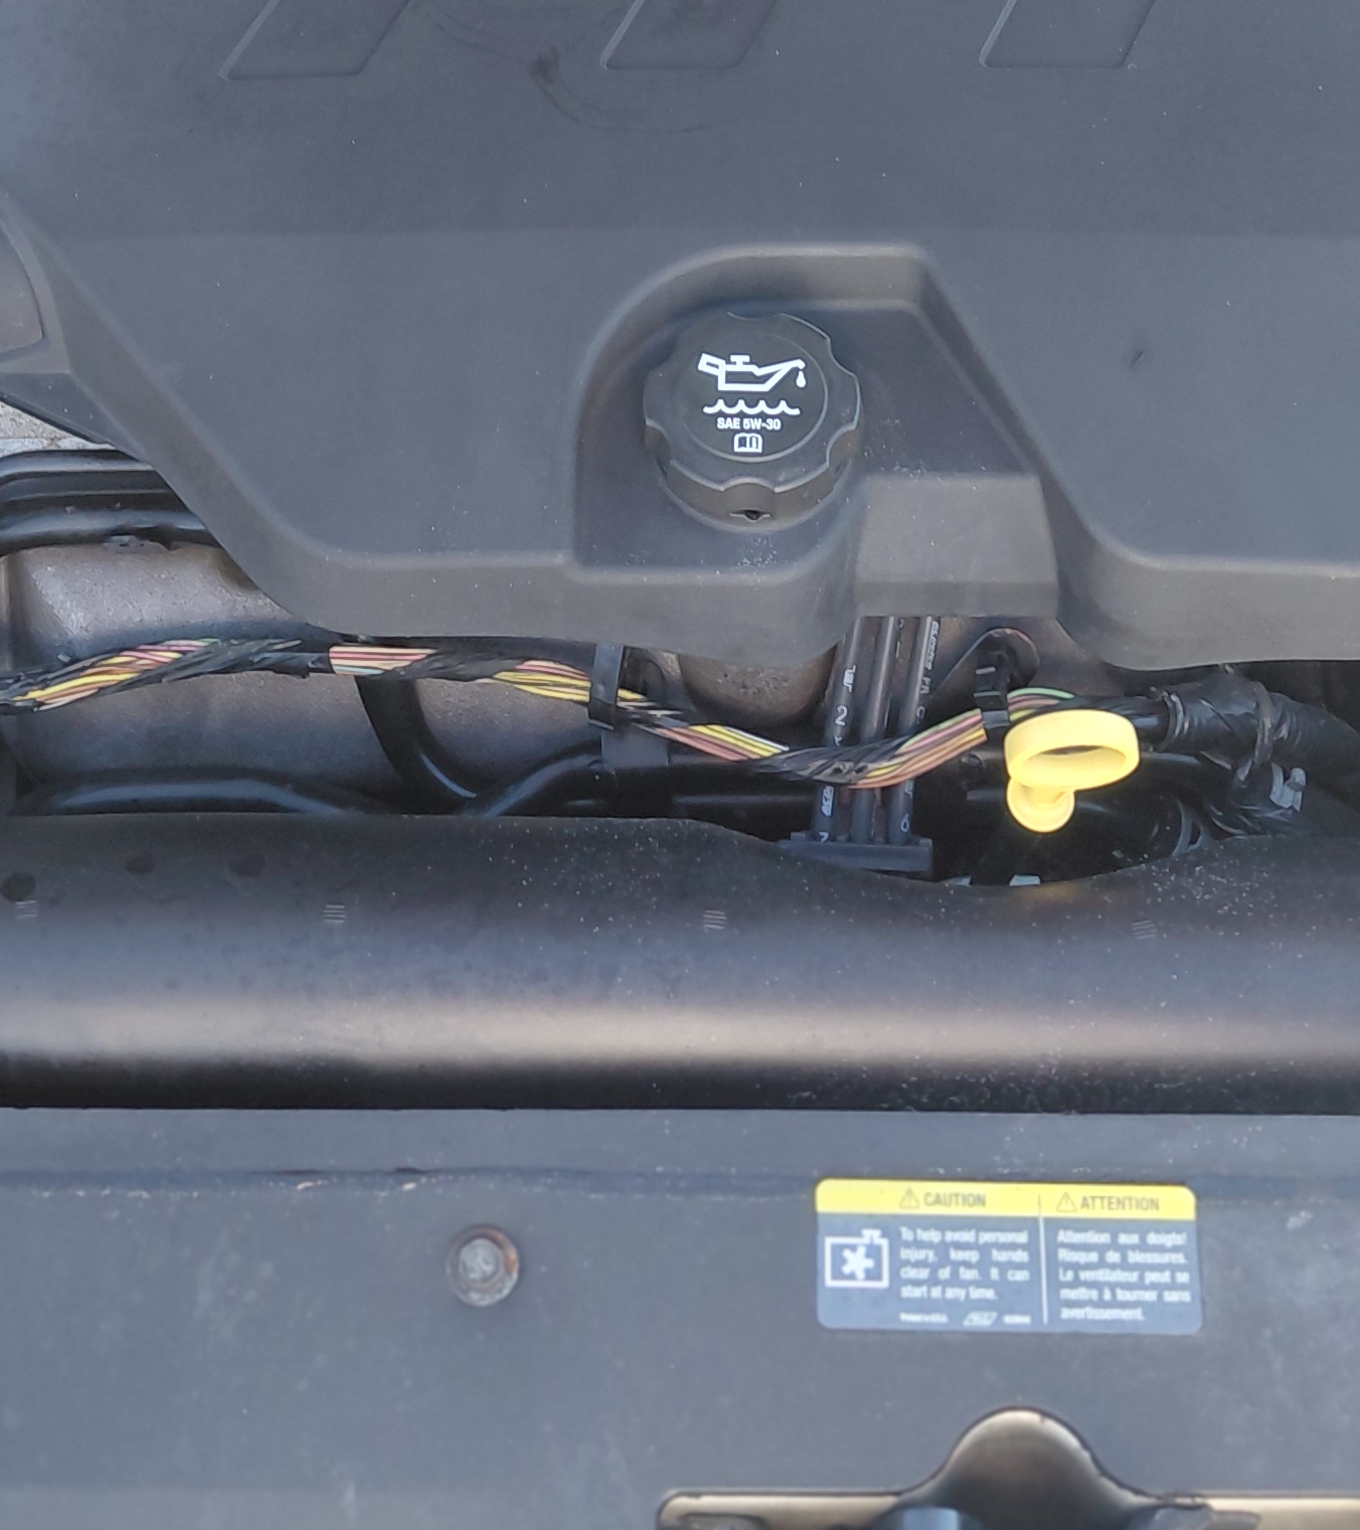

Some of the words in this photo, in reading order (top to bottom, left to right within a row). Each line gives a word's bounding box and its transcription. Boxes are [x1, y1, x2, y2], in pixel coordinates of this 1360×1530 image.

[716, 417, 741, 430] SAE
[742, 417, 781, 431] 5W-30
[924, 1192, 986, 1208] CAUTION
[1080, 1195, 1159, 1211] ATTENTION
[900, 1226, 914, 1241] To
[916, 1228, 942, 1244] help
[944, 1228, 976, 1242] avoid
[978, 1230, 1028, 1245] personal
[1058, 1230, 1111, 1244] Attention
[1118, 1233, 1139, 1244] aux
[900, 1246, 938, 1263] injury,
[949, 1247, 980, 1264] keep
[991, 1248, 1029, 1263] hands
[1058, 1247, 1099, 1264] Risque
[1105, 1248, 1120, 1263] de
[1127, 1249, 1188, 1264] blessures.
[900, 1265, 930, 1279] clear
[939, 1266, 951, 1280] of
[1007, 1270, 1030, 1281] can
[1058, 1267, 1074, 1281] Le
[1078, 1268, 1140, 1282] ventilateur
[1144, 1269, 1171, 1285] peut
[1175, 1271, 1190, 1283] se
[901, 1285, 928, 1298] start
[930, 1285, 942, 1299] at
[945, 1288, 966, 1301] any
[1060, 1287, 1099, 1300] mettre
[1116, 1287, 1158, 1301] tourner
[1163, 1290, 1191, 1302] sans
